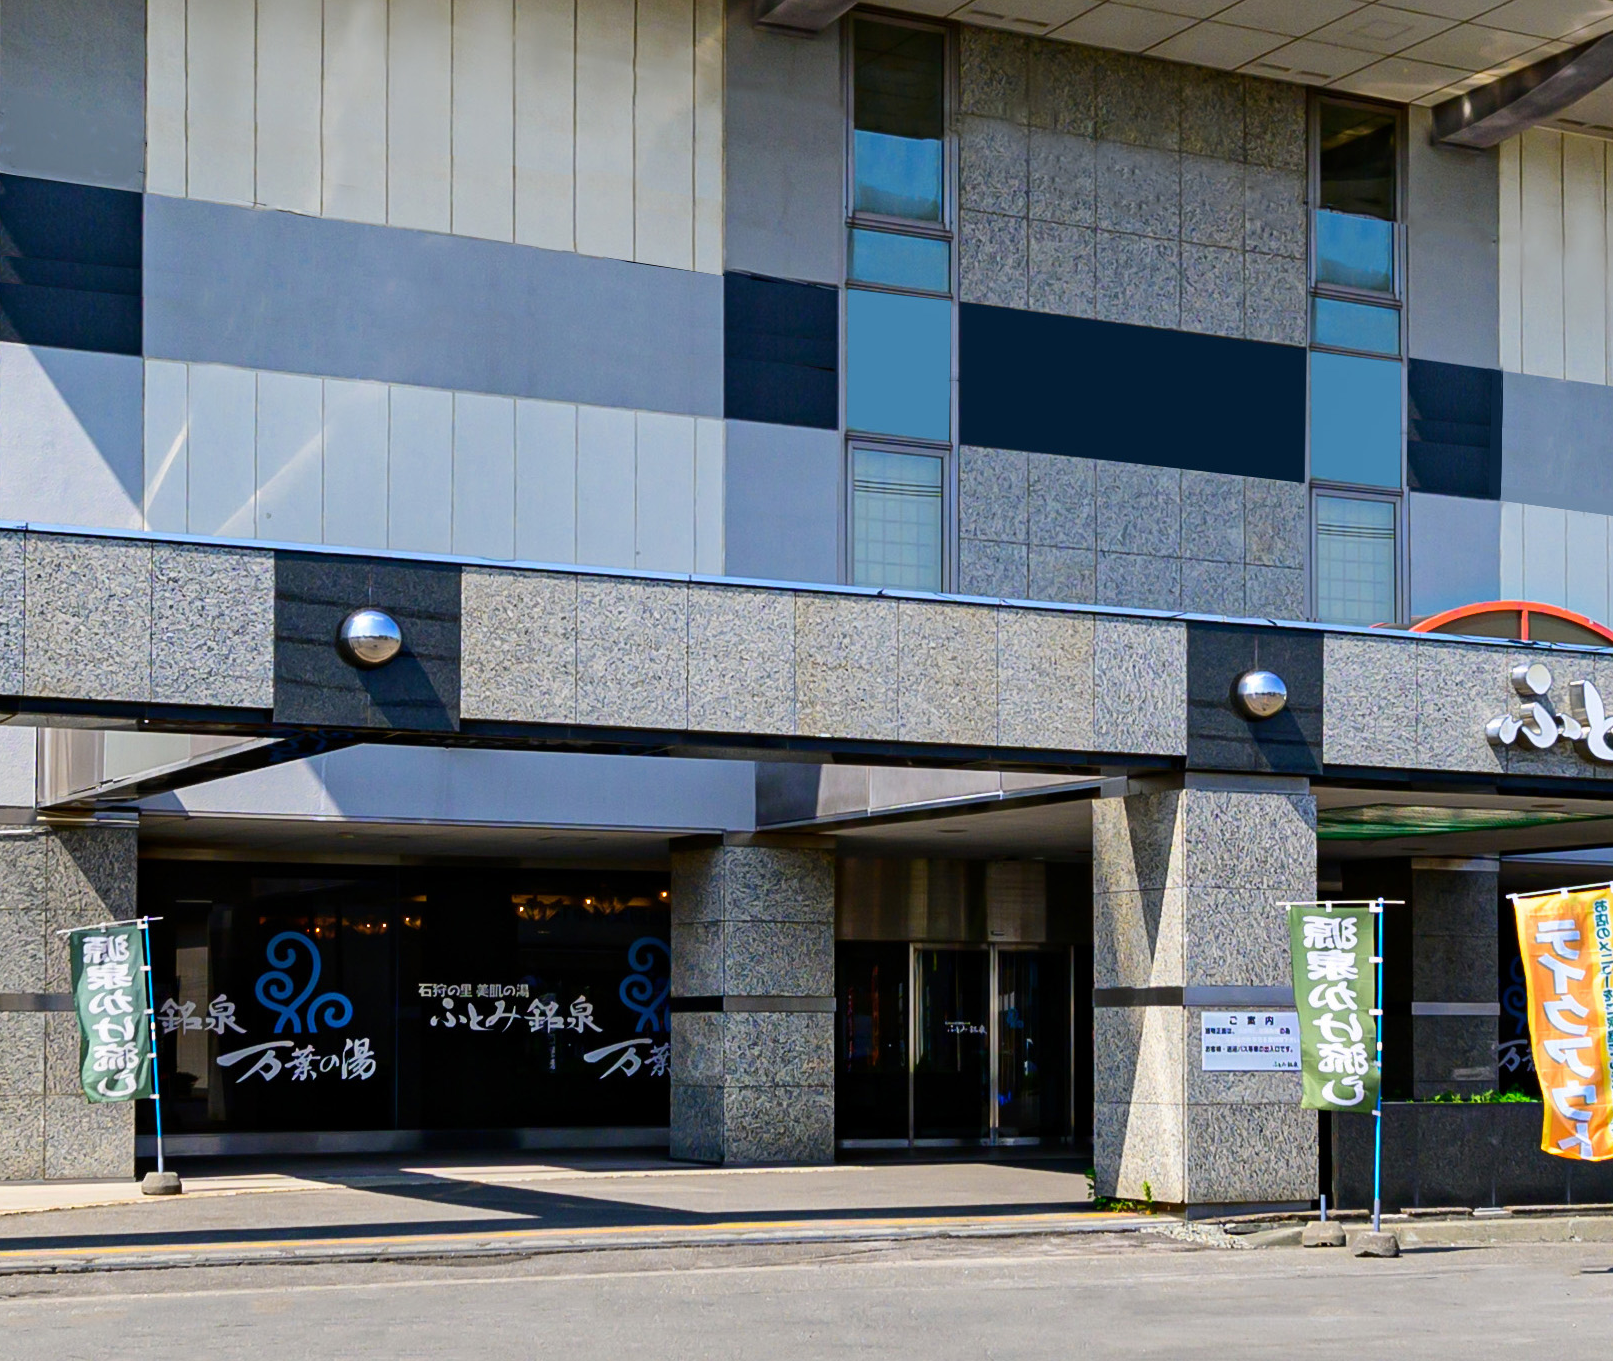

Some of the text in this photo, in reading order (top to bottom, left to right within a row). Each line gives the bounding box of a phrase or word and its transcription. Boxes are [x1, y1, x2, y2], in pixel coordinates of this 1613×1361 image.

[418, 982, 530, 998] 石狩の里 美肌の湯
[157, 993, 248, 1035] 銘泉
[429, 994, 604, 1034] ふとみ銘泉
[216, 1037, 377, 1084] 万葉の湯
